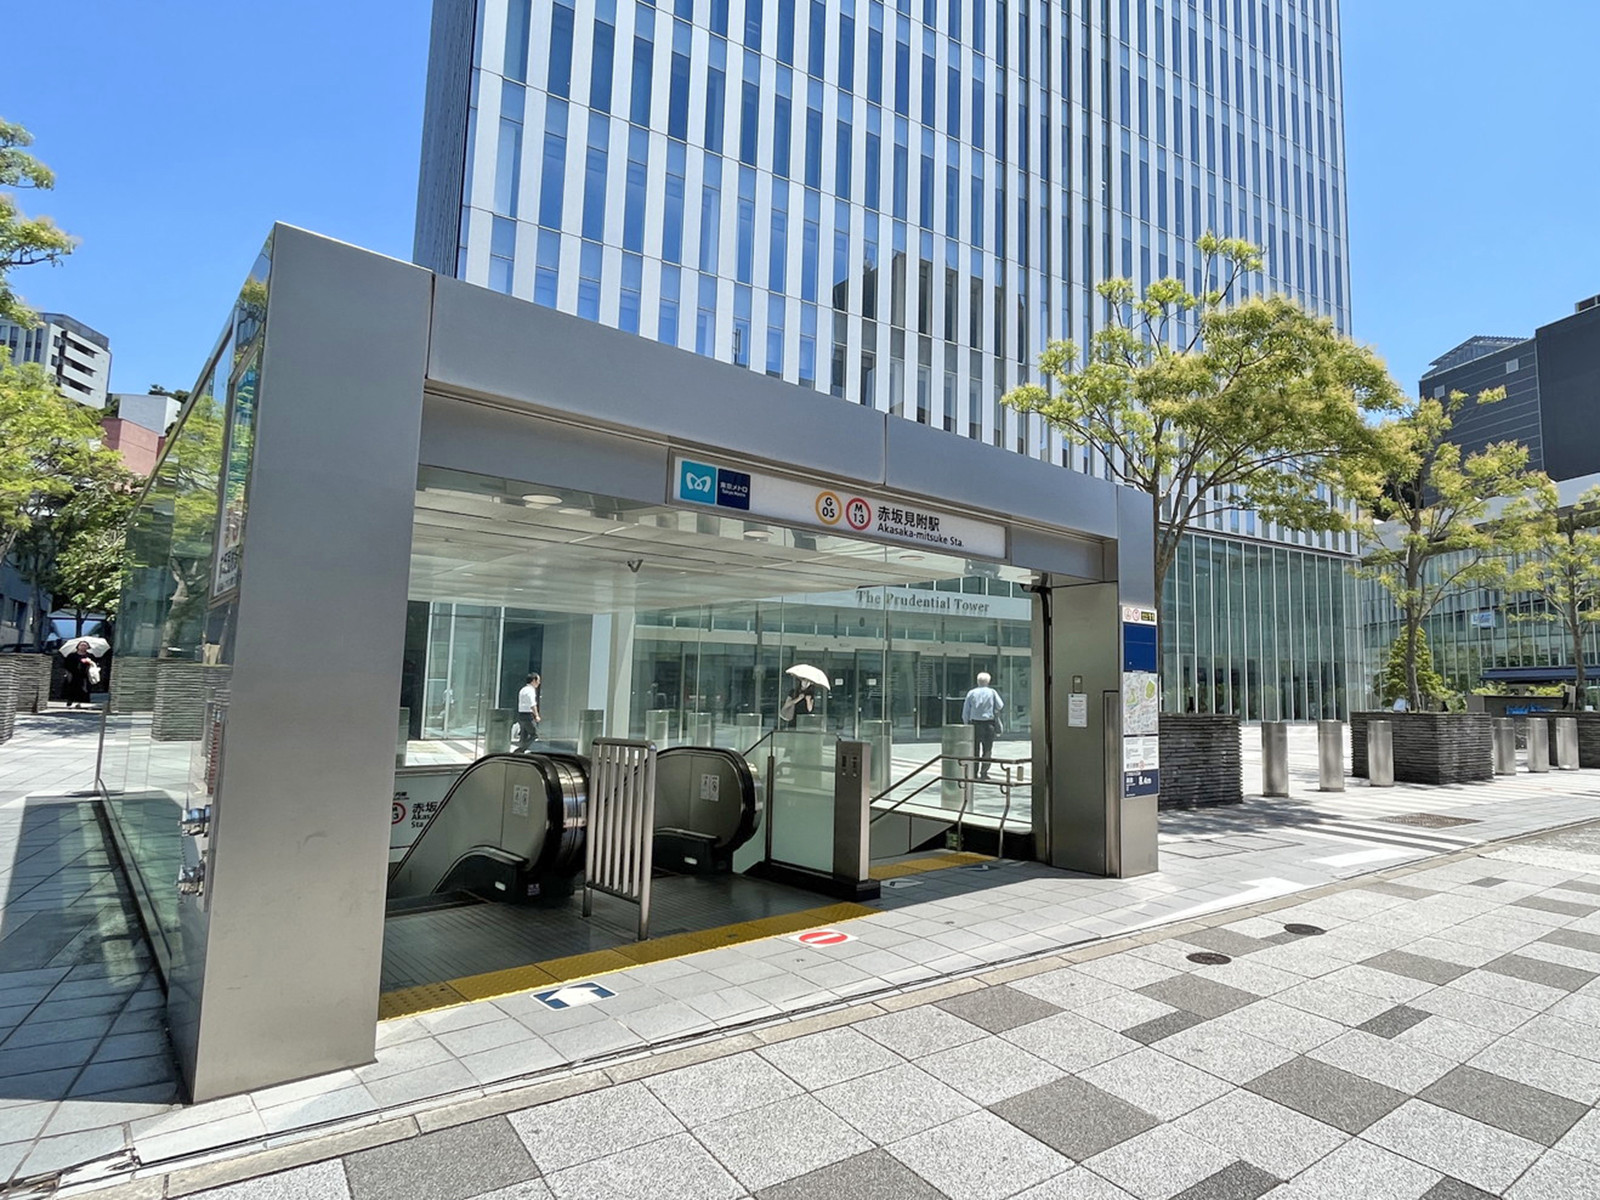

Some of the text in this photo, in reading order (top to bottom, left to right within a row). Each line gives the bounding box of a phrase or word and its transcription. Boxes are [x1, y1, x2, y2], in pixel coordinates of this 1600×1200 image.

[825, 496, 833, 507] G
[822, 506, 835, 518] 05
[855, 503, 863, 513] M
[853, 512, 865, 524] 13
[878, 506, 940, 532] 赤坂見附駅
[877, 522, 965, 547] Akasaka-mitsuke Sta.
[856, 590, 990, 612] The Prudential Tower
